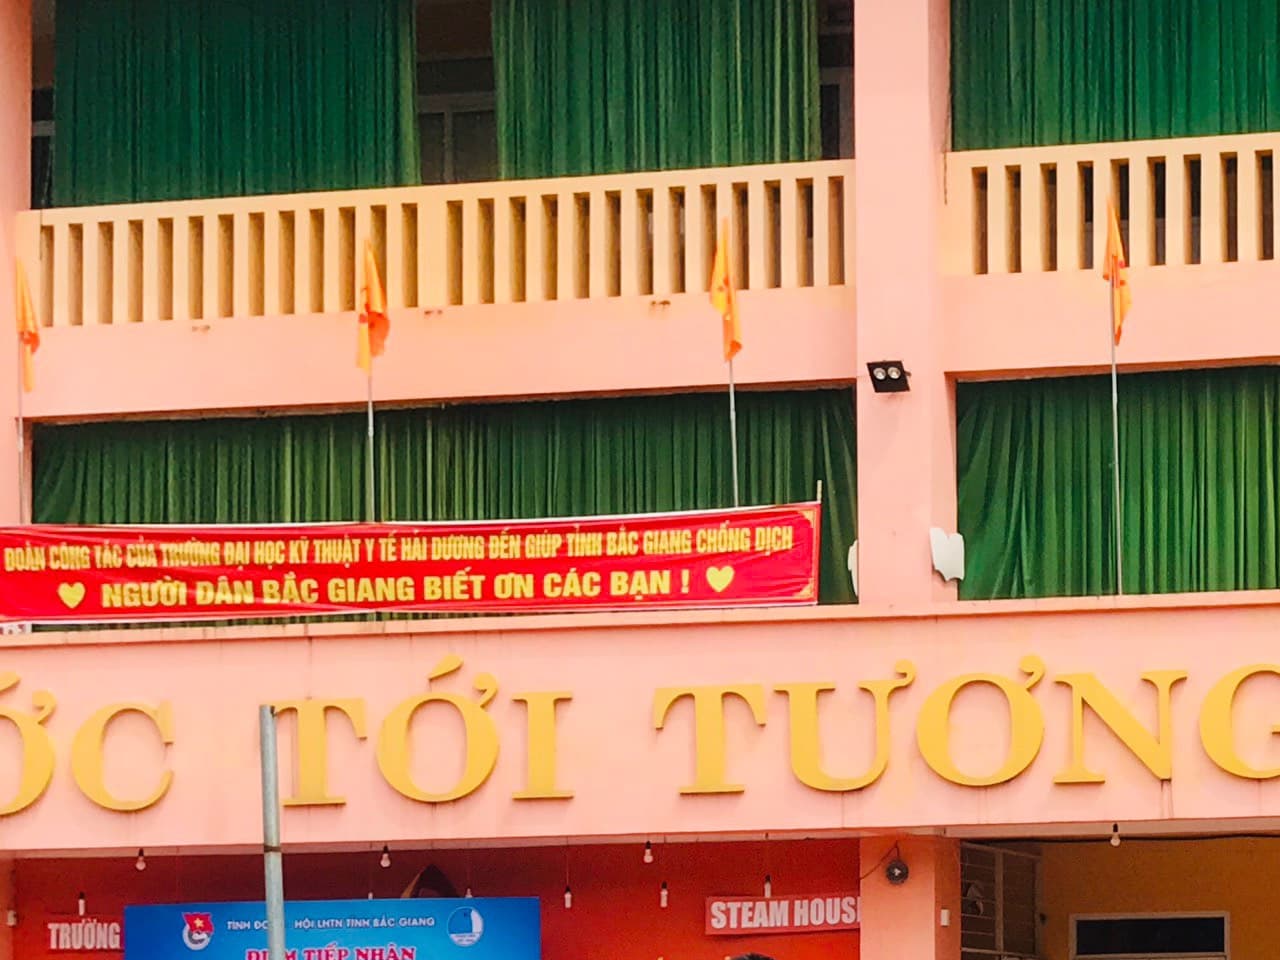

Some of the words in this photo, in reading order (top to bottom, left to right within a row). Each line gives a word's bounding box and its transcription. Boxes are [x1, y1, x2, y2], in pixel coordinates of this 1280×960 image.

[5, 540, 46, 571] ĐOÀN
[50, 542, 91, 569] CÔNG
[94, 538, 123, 568] TÁC
[126, 535, 157, 567] CỦA
[160, 537, 221, 567] TRƯỜNG
[224, 541, 250, 570] ĐẠI
[254, 541, 285, 570] HỌC
[313, 533, 361, 568] THUẬT
[365, 538, 375, 562] Y
[379, 529, 396, 562] TẾ
[401, 529, 427, 562] HẢI
[431, 534, 484, 561] DƯƠNG
[489, 527, 520, 559] ĐẾN
[525, 529, 562, 558] GIÚP
[567, 523, 602, 557] TỈNH
[606, 524, 638, 556] BẮC
[643, 528, 692, 555] GIANG
[696, 520, 750, 553] CHỐNG
[755, 526, 793, 556] DỊCH
[102, 575, 187, 607] NGƯỜI
[196, 576, 254, 605] DÂN
[262, 571, 319, 604] BẮC
[327, 576, 415, 604] GIANG
[423, 566, 486, 600] BIẾT
[494, 572, 534, 599] ƠN
[544, 567, 601, 598] CÁC
[610, 570, 671, 600] BẠN
[681, 569, 690, 593] !
[273, 655, 575, 806] TỚI
[398, 917, 435, 927] GIANG
[711, 900, 789, 929] STEAM
[48, 918, 121, 949] TRƯỜNG
